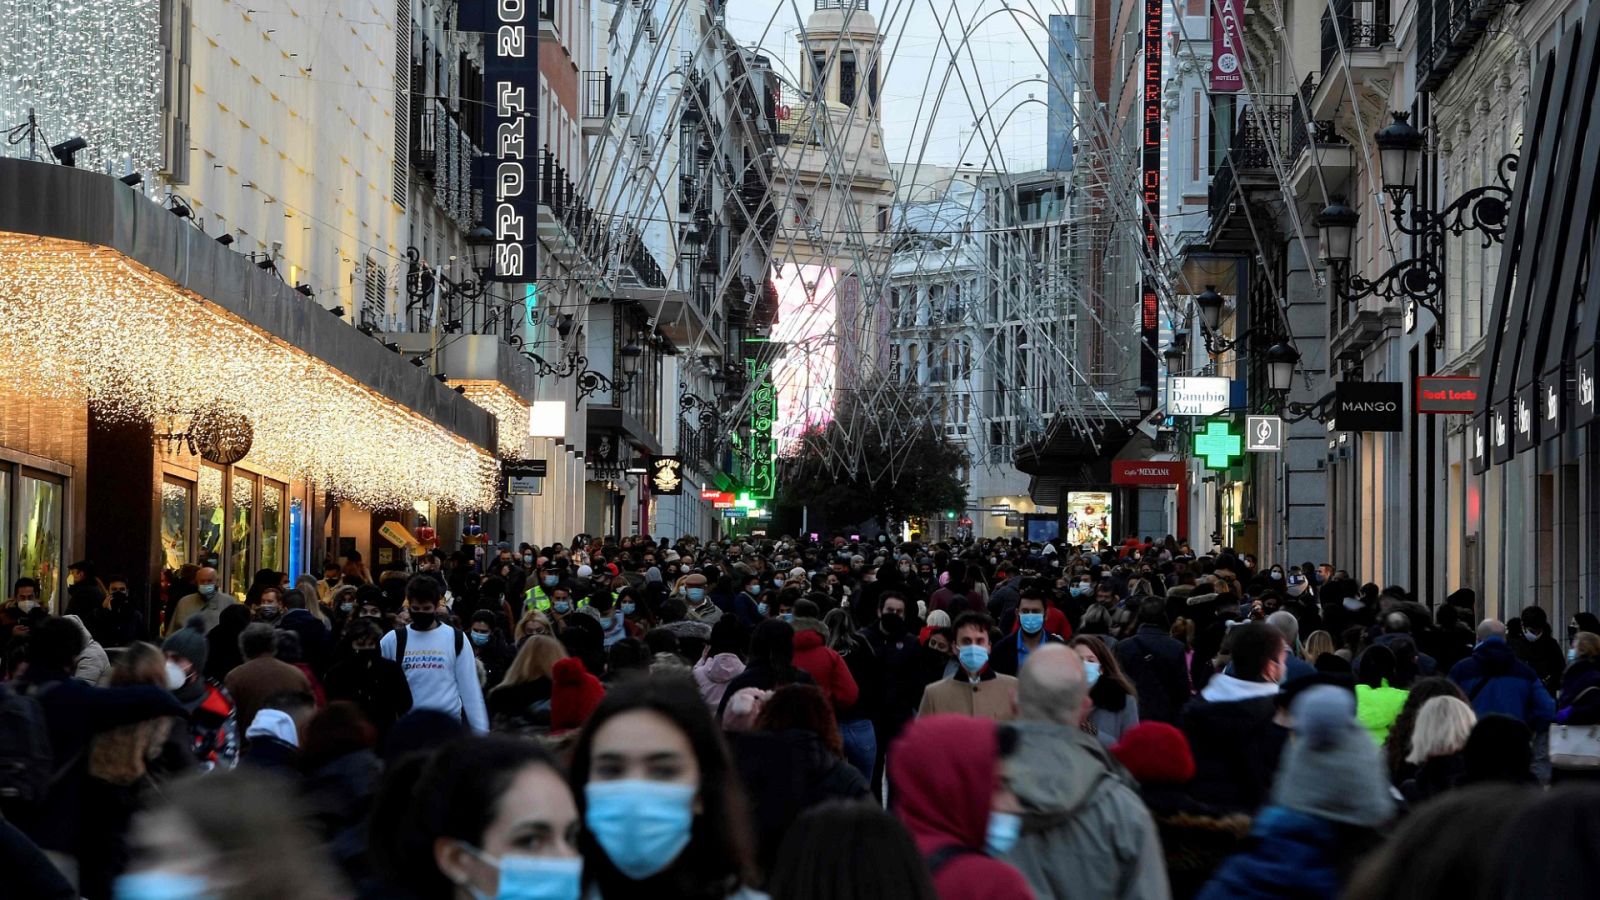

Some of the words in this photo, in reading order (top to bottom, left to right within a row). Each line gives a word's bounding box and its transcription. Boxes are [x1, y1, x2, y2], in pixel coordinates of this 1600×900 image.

[1145, 0, 1161, 145] GENERAL
[496, 82, 525, 276] SPORT
[1172, 378, 1186, 390] El
[1172, 391, 1225, 402] Danubio
[1172, 402, 1202, 414] Azul
[1342, 401, 1397, 412] MANGO
[594, 470, 620, 480] REYES
